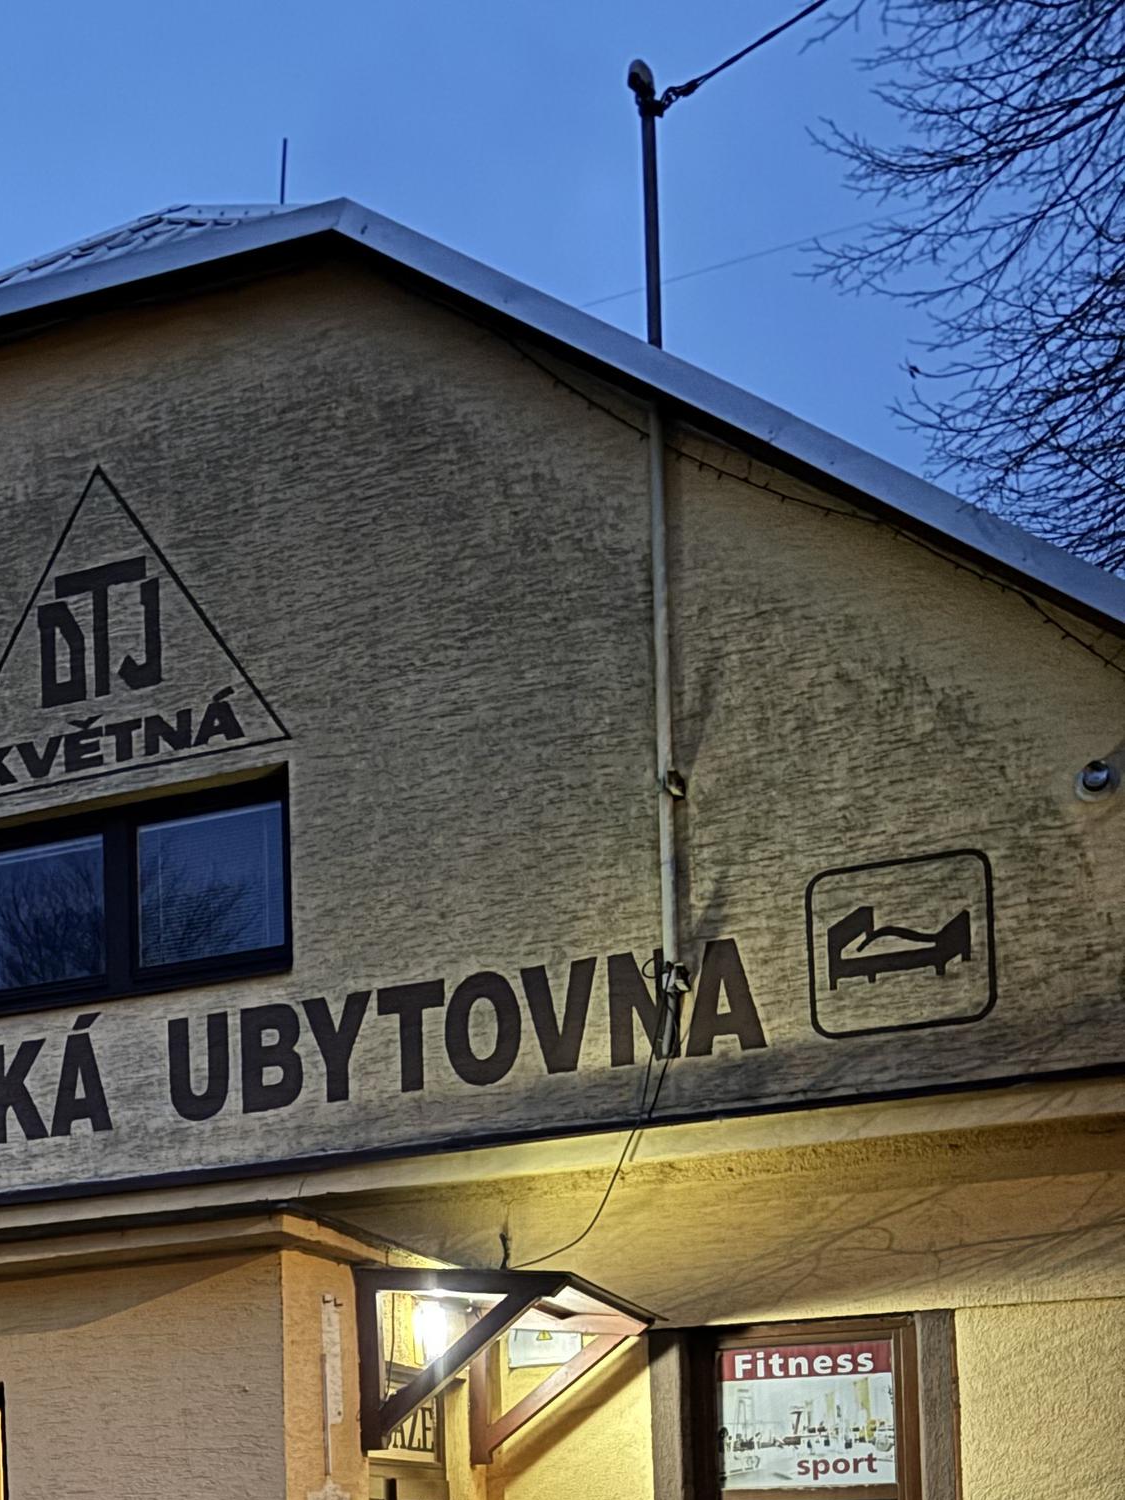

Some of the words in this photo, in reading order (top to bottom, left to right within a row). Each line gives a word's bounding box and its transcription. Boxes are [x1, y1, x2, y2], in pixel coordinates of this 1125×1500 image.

[37, 556, 163, 709] DTJ
[167, 938, 768, 1121] UBYTOVNA
[734, 1351, 874, 1379] Fitness
[796, 1453, 878, 1480] sport
